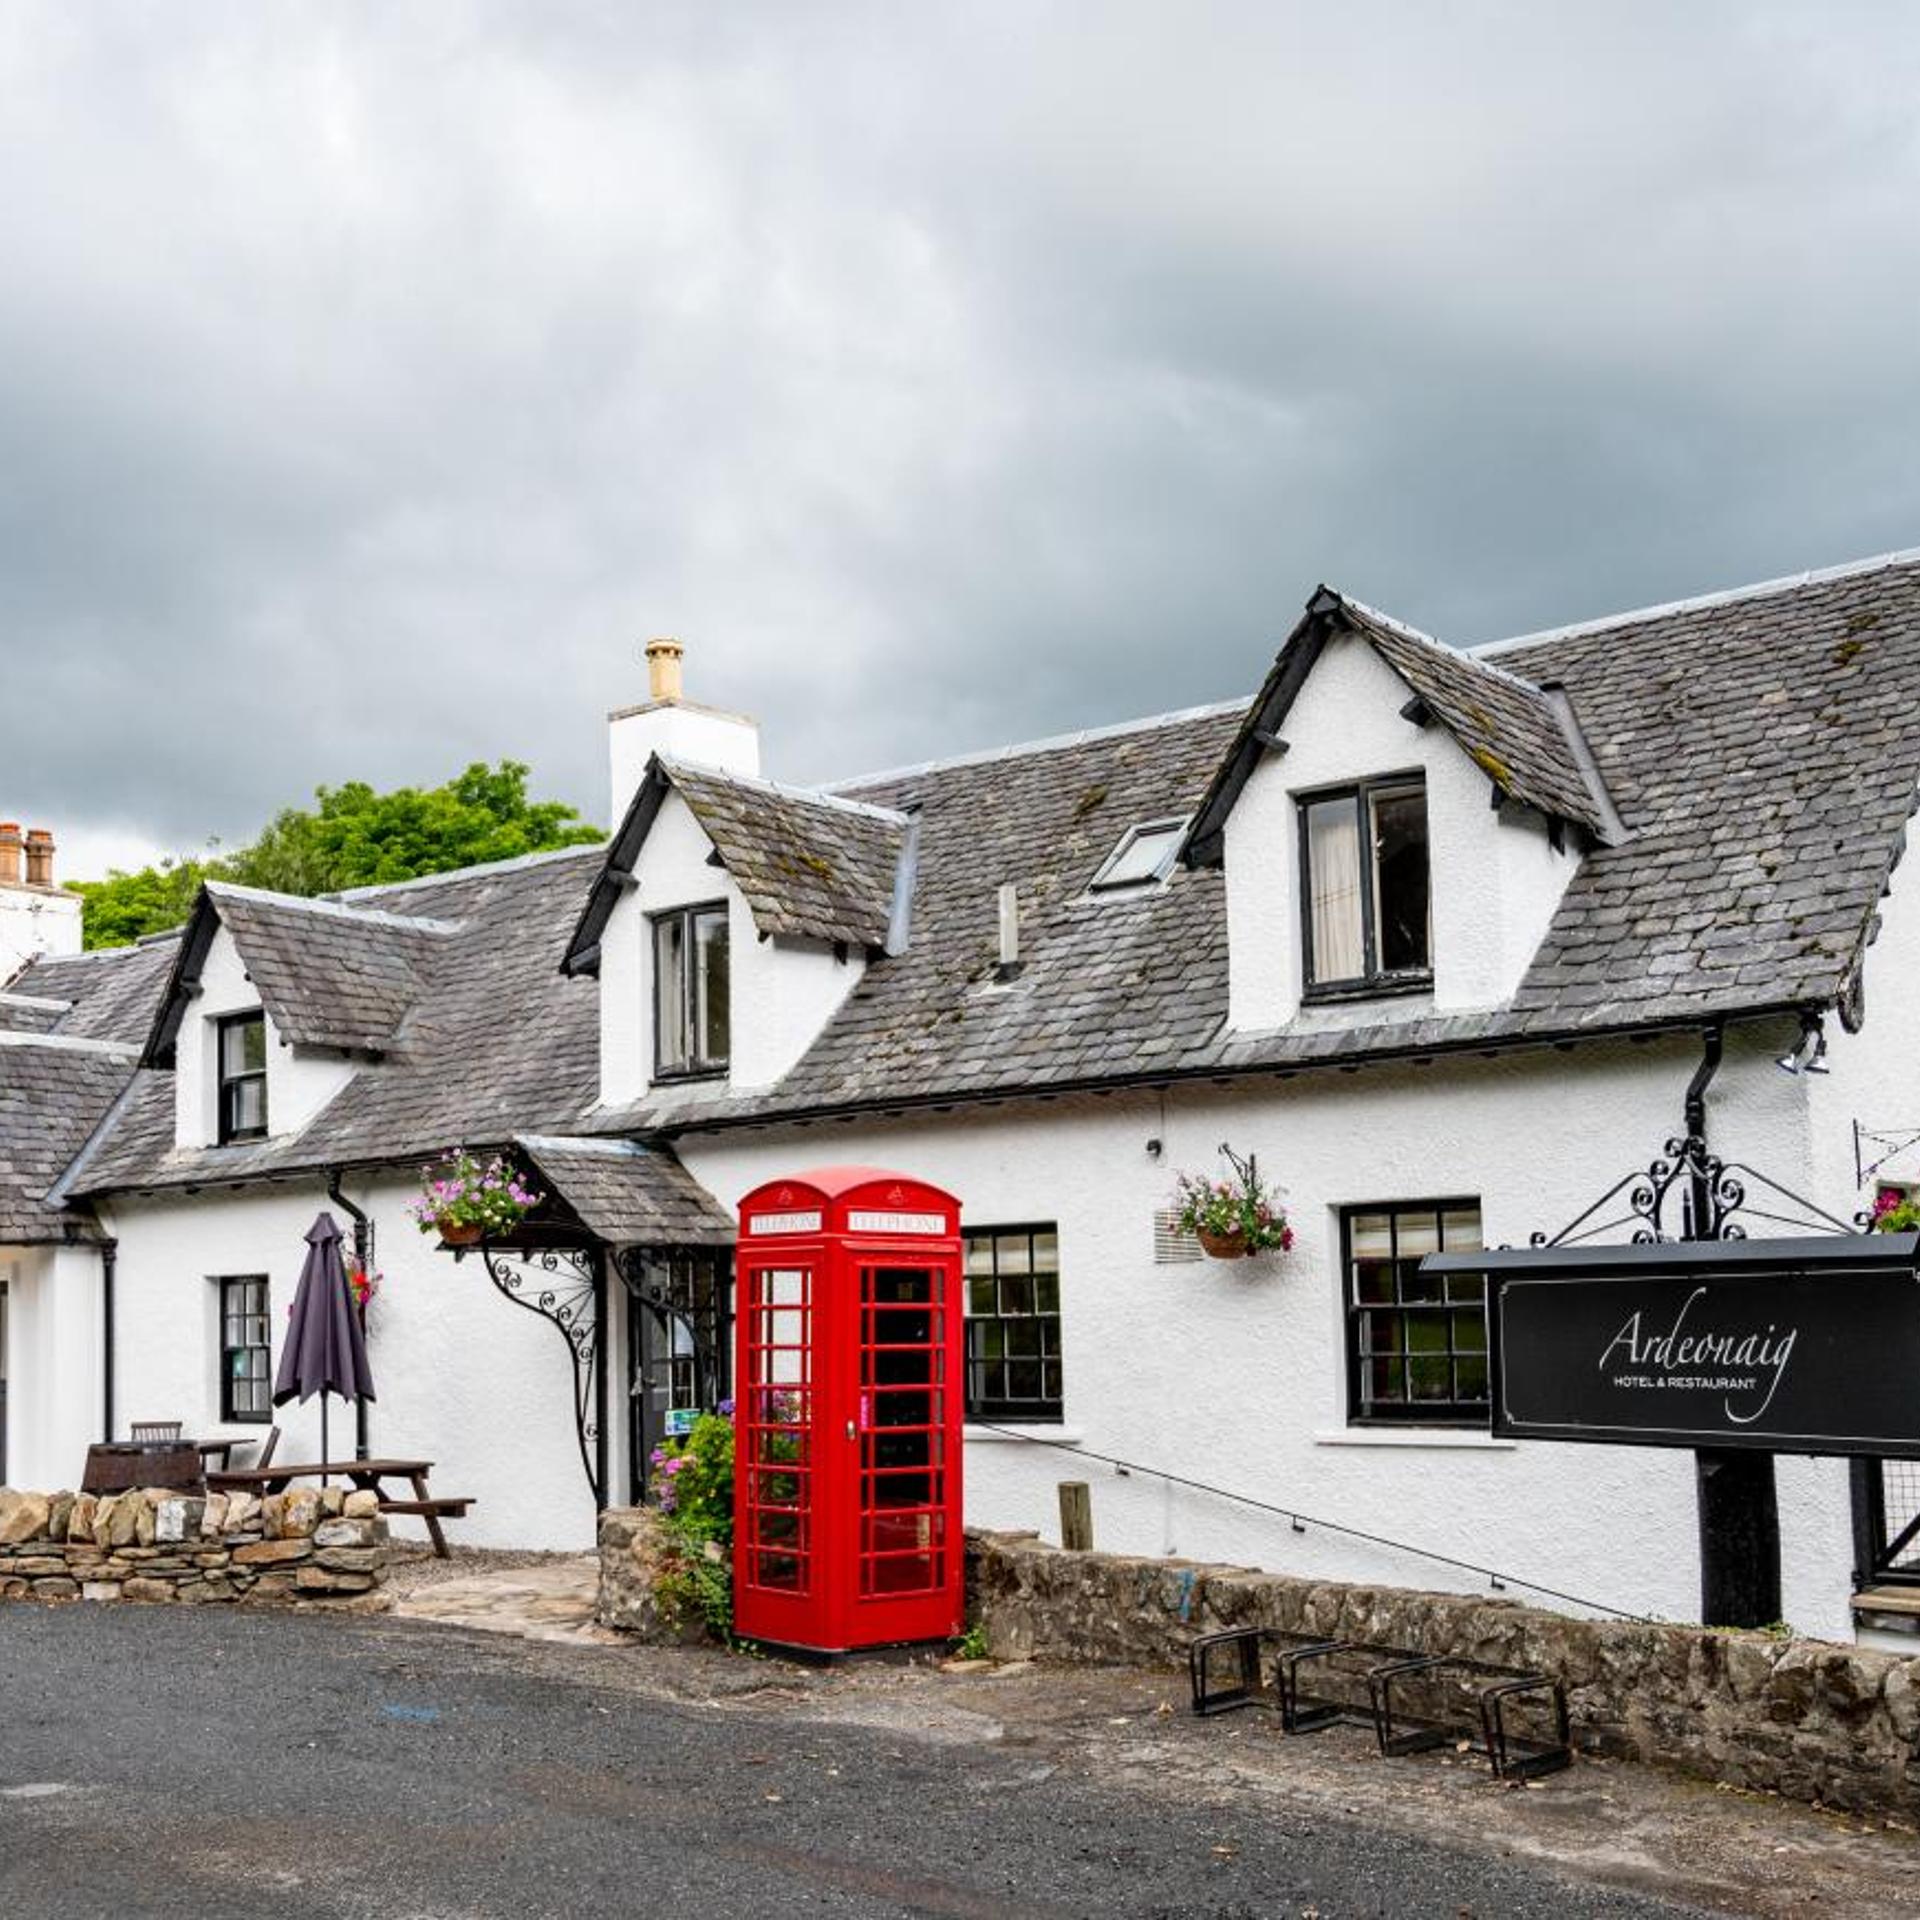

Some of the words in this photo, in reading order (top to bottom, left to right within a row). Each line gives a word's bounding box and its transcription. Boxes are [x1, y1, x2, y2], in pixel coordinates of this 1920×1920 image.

[1599, 1286, 1797, 1423] Ardeonaig
[1613, 1375, 1656, 1388] HOTEL
[1656, 1376, 1667, 1388] &
[1667, 1376, 1757, 1390] RESTAURANT
